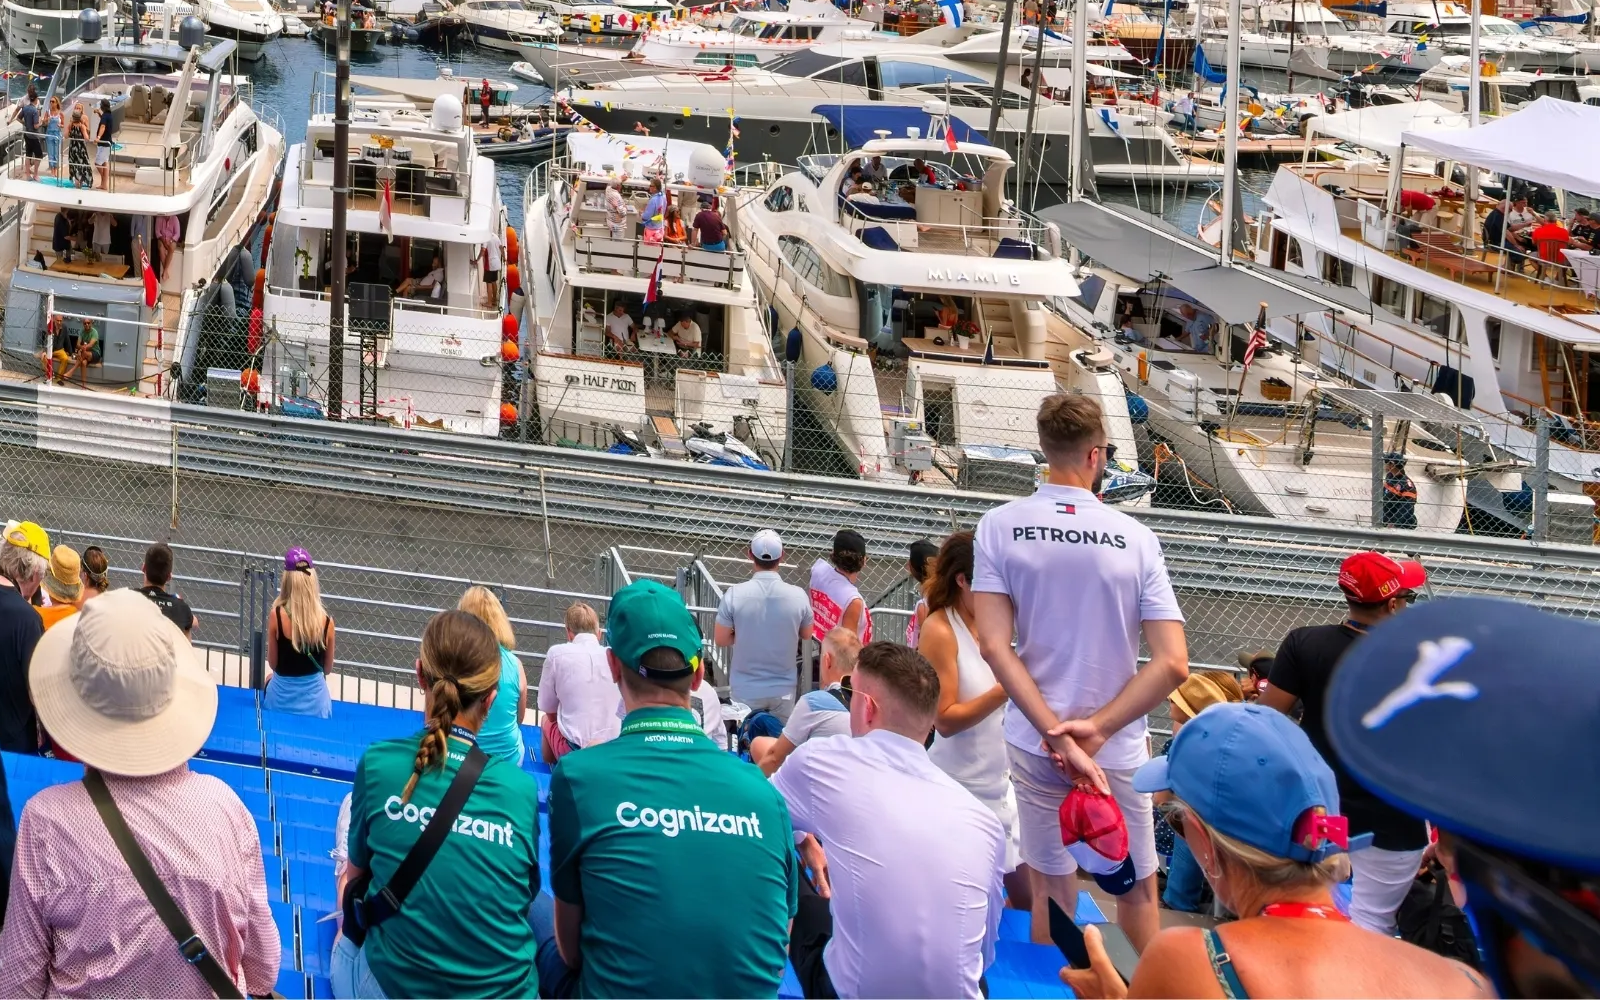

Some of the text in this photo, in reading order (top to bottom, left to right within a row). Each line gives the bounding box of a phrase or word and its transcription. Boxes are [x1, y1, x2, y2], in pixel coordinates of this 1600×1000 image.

[928, 268, 1020, 286] MIAMI B
[583, 374, 636, 392] HALF MOON
[1012, 526, 1127, 549] PETRONAS
[628, 723, 640, 731] your
[644, 734, 694, 744] ASTON MARTIN
[615, 801, 763, 838] Cognizant
